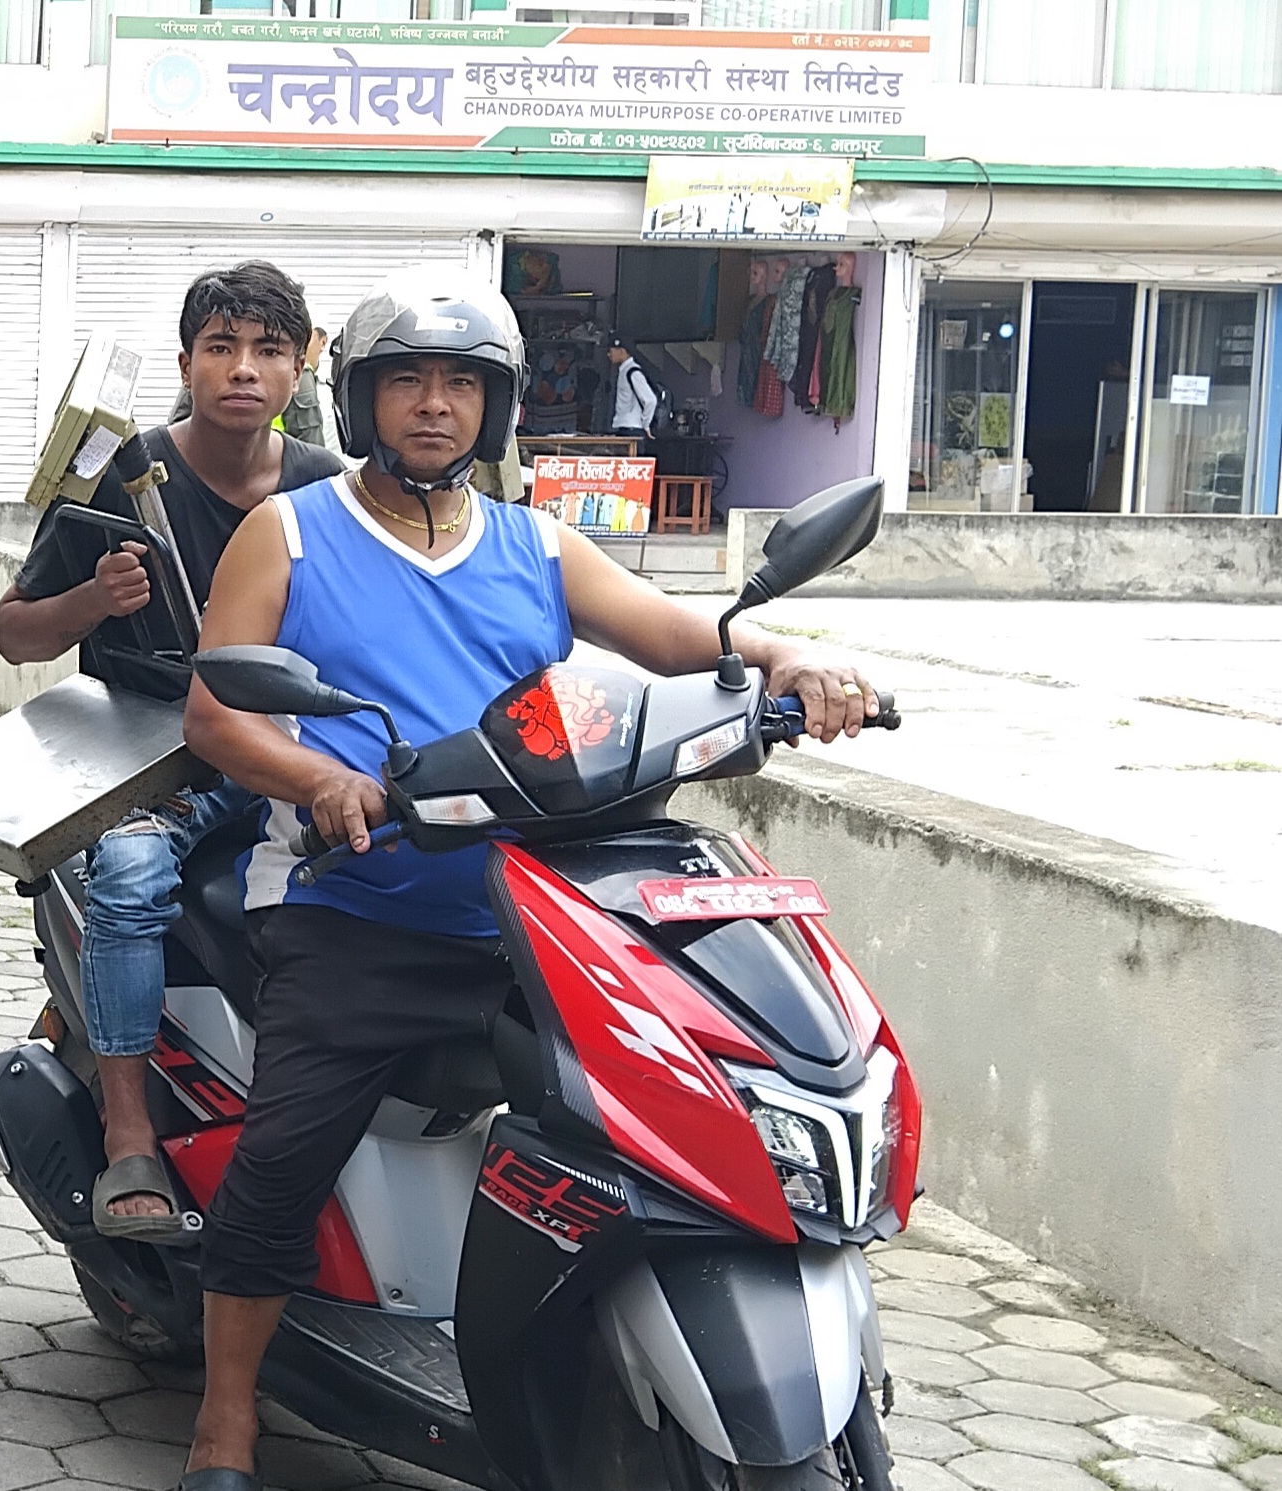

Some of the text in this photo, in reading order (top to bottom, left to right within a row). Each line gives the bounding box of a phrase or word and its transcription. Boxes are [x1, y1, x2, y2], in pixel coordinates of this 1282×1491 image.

[231, 24, 255, 36] बचत
[228, 46, 454, 126] चन्द्रोदय
[465, 56, 903, 97] बहुउद्देश्यीय सहकारी संस्था लिमिटेड
[464, 101, 902, 125] CHANDRODAYA MULTIPURPOSE CO-OPERATIVE LIMITED
[549, 129, 585, 147] फोन
[577, 457, 616, 482] सिलाई
[617, 459, 653, 481] सेन्टर
[486, 1181, 531, 1214] RACE
